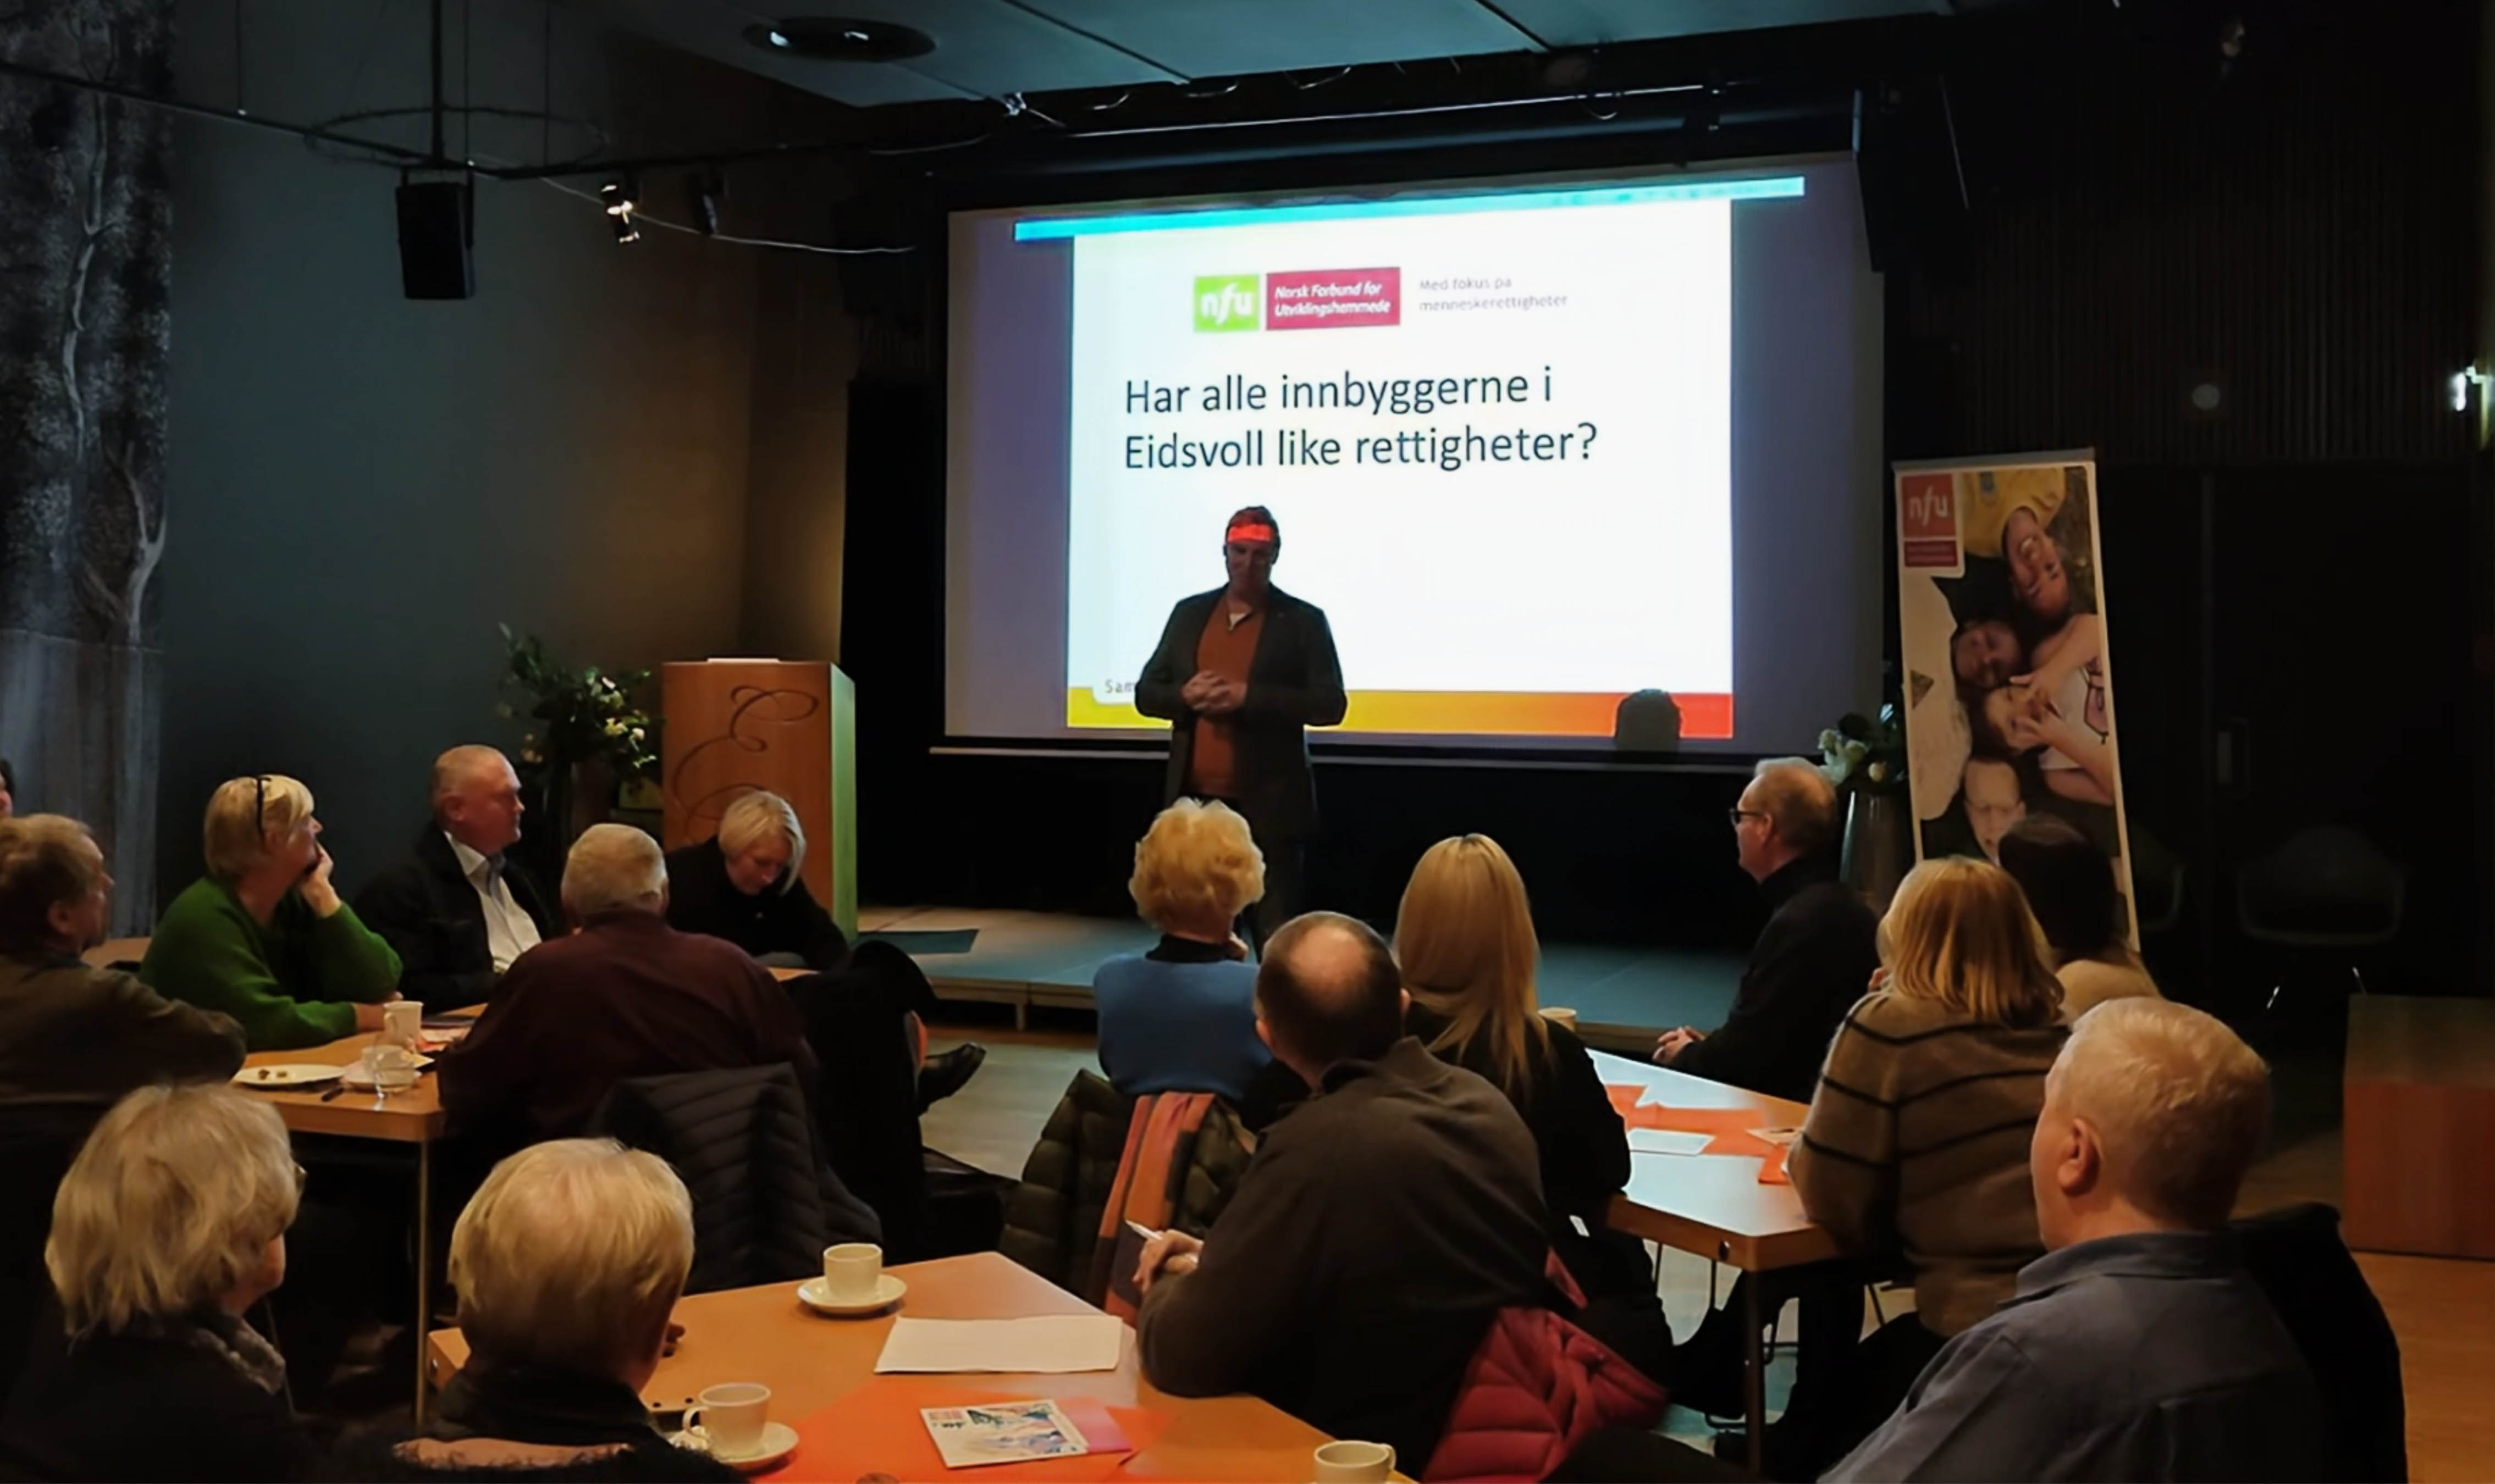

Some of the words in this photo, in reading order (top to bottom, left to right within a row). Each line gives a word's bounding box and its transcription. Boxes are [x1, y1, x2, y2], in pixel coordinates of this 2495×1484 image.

[1274, 284, 1309, 300] Norsk
[1311, 282, 1362, 297] Forbund
[1364, 280, 1383, 296] for
[1420, 279, 1449, 290] Med
[1453, 278, 1490, 290] fokus
[1200, 282, 1252, 325] nfu
[1420, 295, 1567, 311] menneskerettigheter
[1126, 379, 1190, 413] Har
[1202, 374, 1267, 411] alle
[1282, 370, 1528, 415] innbyggerne
[1544, 366, 1551, 402] i
[1126, 429, 1263, 468] Eidsvoll
[1279, 429, 1341, 466] like
[1357, 422, 1597, 471] rettigheter?
[1908, 486, 1948, 527] nfu
[1105, 679, 1136, 693] Sam
